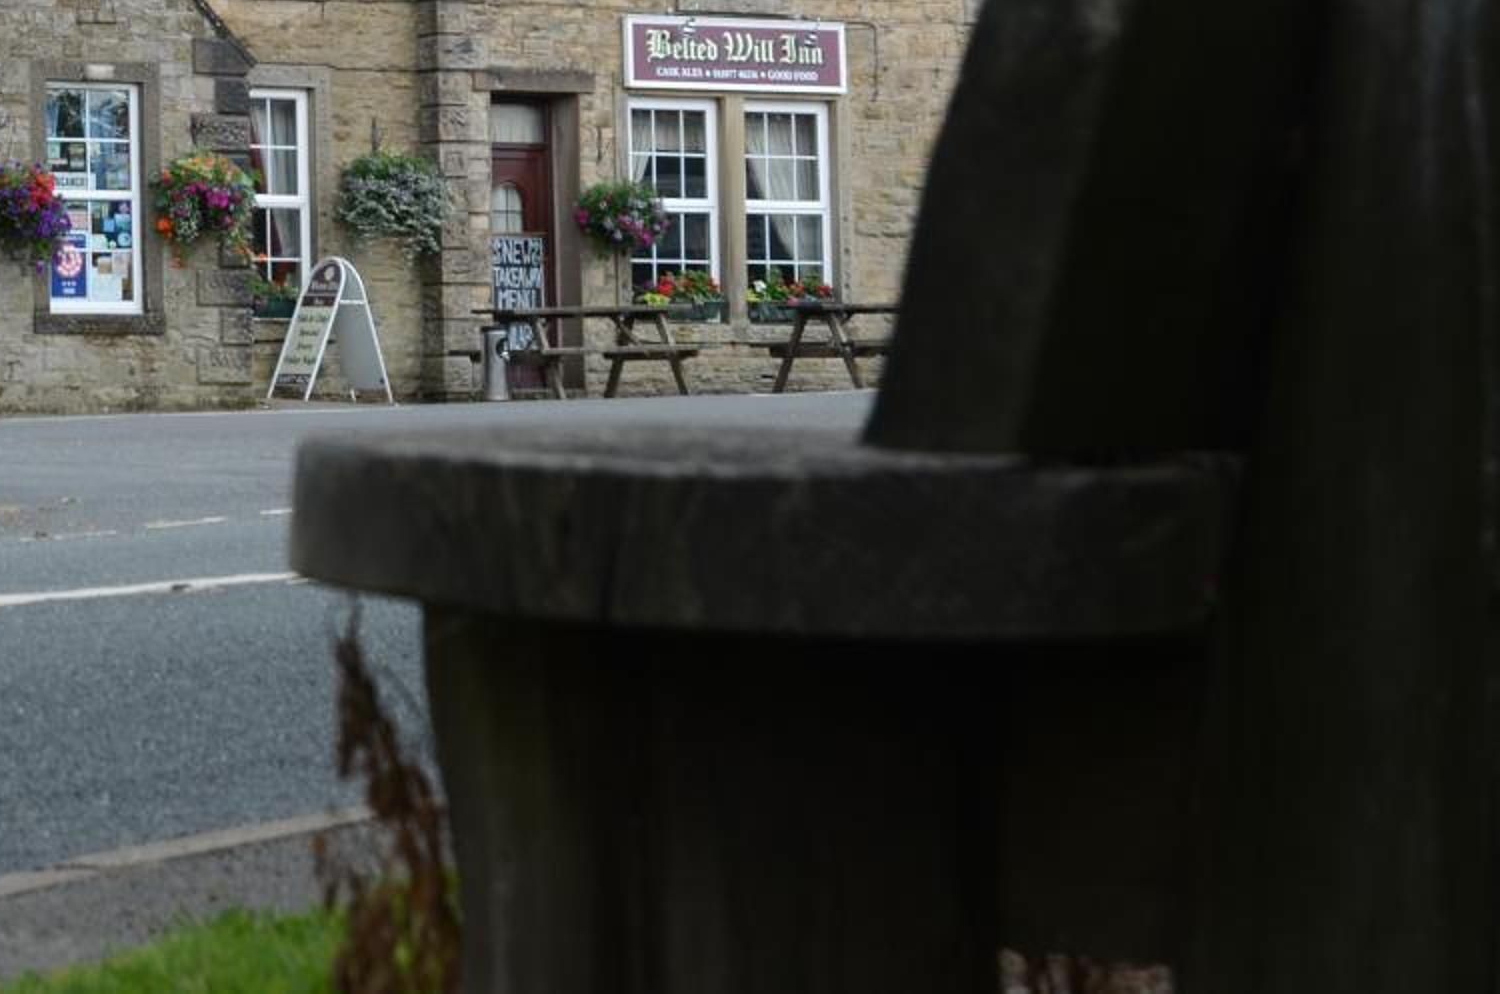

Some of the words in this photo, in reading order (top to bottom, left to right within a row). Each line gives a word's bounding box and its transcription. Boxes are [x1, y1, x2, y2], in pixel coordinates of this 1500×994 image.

[645, 29, 718, 62] Belted
[722, 31, 774, 63] Will
[779, 34, 823, 64] Inn
